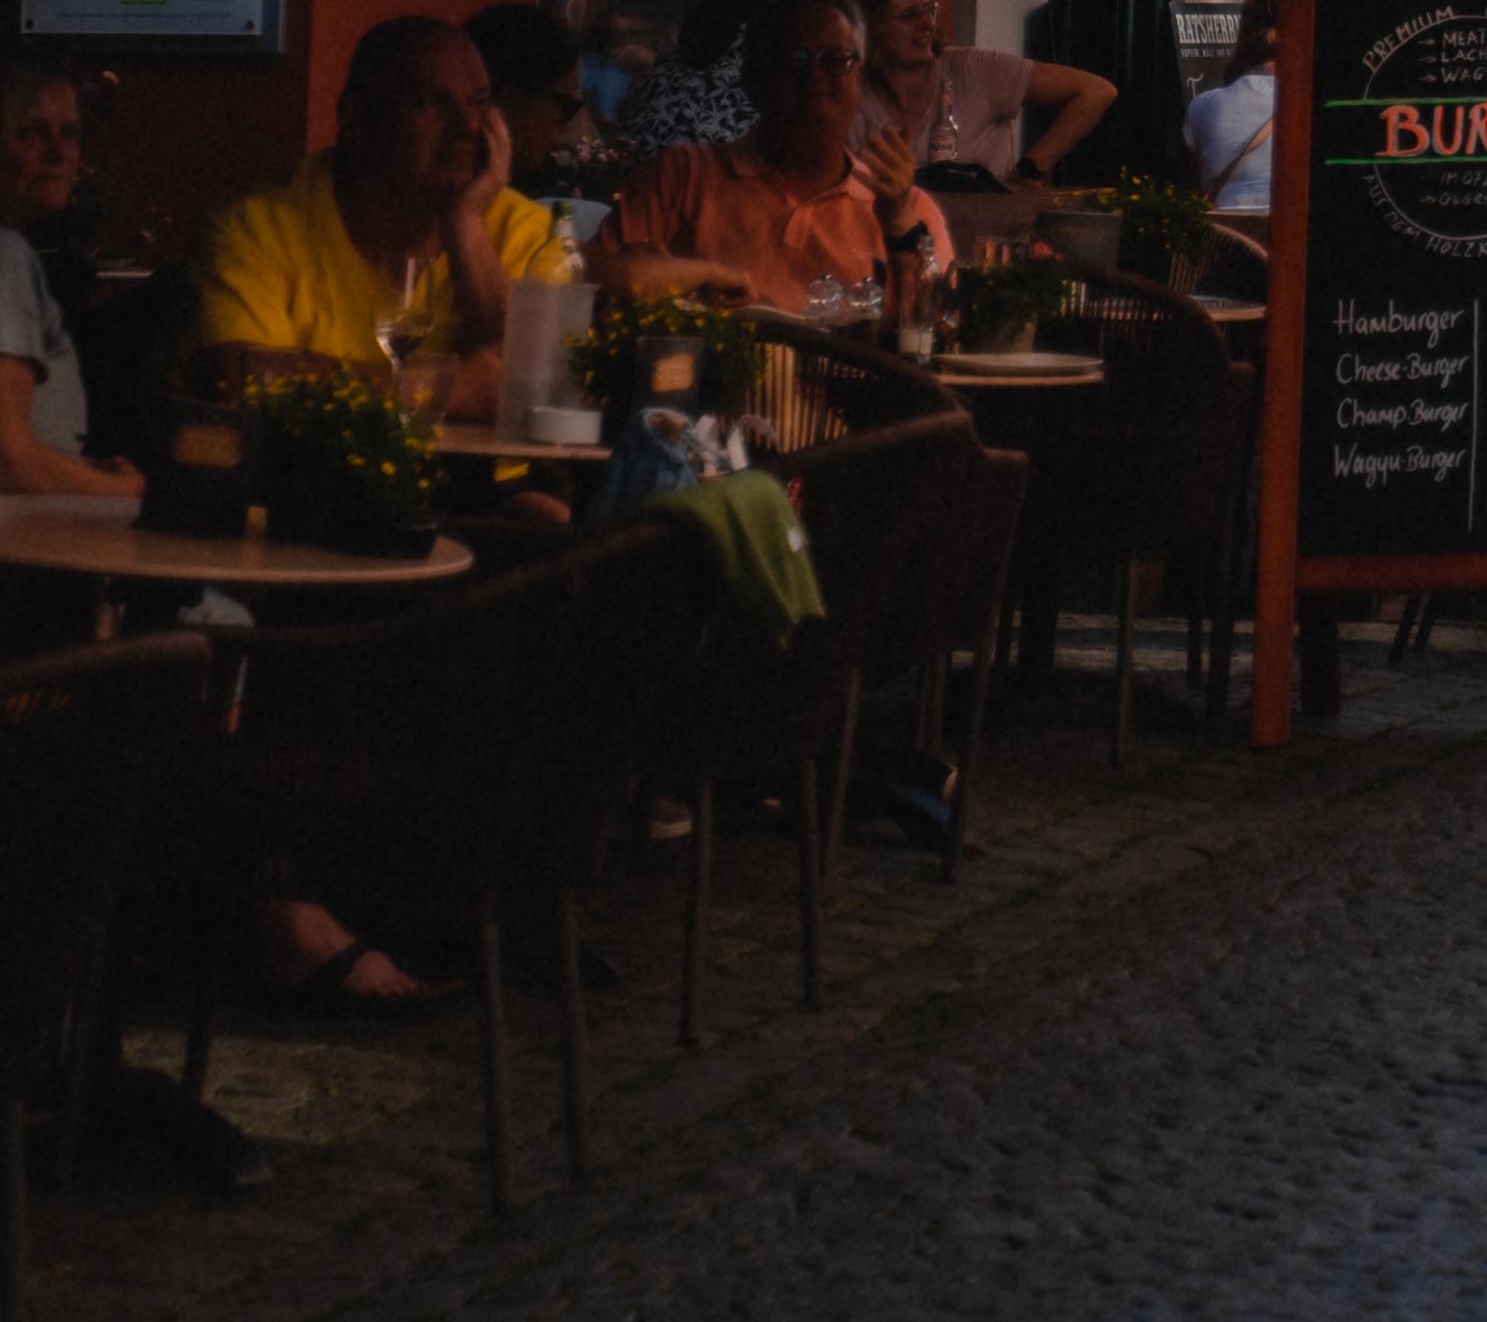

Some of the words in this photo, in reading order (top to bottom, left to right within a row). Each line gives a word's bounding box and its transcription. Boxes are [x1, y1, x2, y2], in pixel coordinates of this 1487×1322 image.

[1361, 5, 1455, 74] PREMIUM
[1441, 28, 1487, 47] MEAT
[1333, 298, 1464, 349] Hamburger
[1336, 353, 1470, 389] Cheese-Burger
[1333, 442, 1467, 489] Wagyu-Burger
